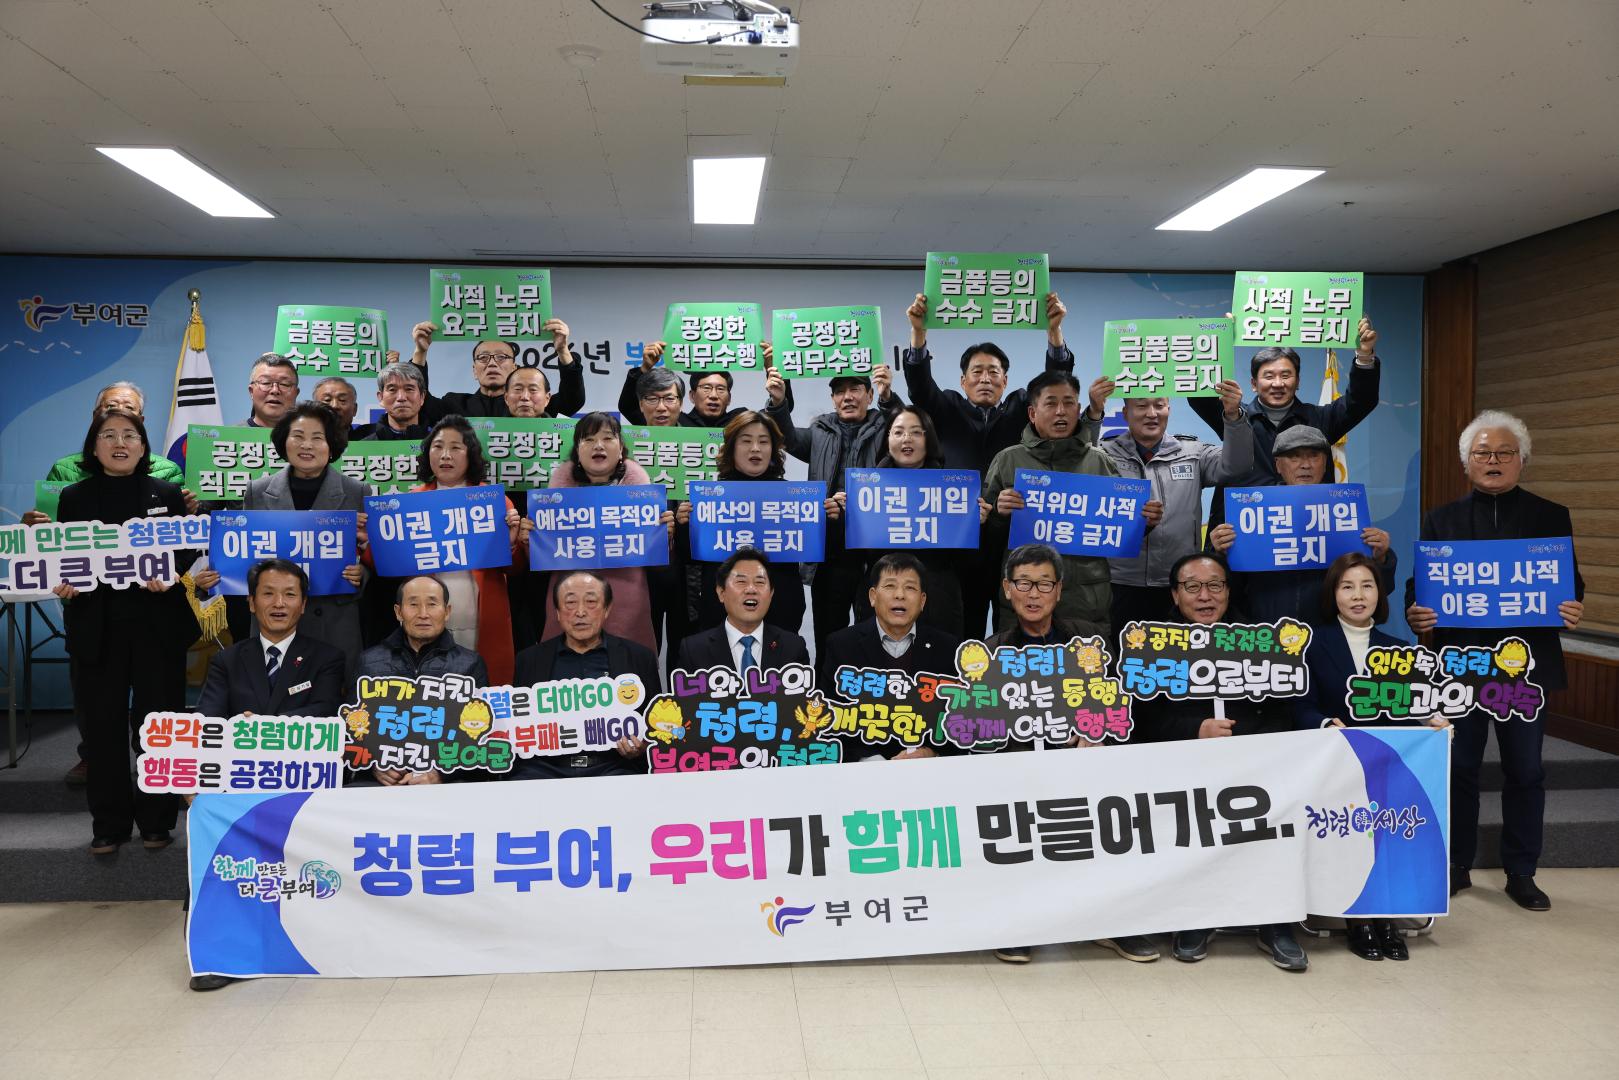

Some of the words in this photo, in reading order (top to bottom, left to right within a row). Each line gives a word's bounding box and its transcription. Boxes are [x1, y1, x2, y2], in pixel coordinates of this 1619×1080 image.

[442, 284, 486, 309] 사적
[494, 284, 541, 308] 노무
[939, 269, 1036, 297] 금품등의
[72, 302, 149, 326] 부여군
[935, 299, 985, 325] 수수
[991, 299, 1039, 325] 금지
[1243, 288, 1293, 315] 사적
[1301, 288, 1352, 315] 노무
[288, 319, 379, 346] 금품등의
[442, 312, 488, 337] 요구
[495, 312, 541, 337] 금지
[680, 316, 747, 341] 공정한
[791, 320, 860, 347] 공정한
[1242, 317, 1291, 343] 요구
[1300, 317, 1349, 343] 금지
[285, 346, 330, 372] 수수
[338, 348, 383, 373] 금지
[671, 343, 757, 369] 직무수행
[782, 348, 872, 375] 직무수행
[1119, 334, 1219, 363] 금품등의
[1114, 365, 1165, 394] 수수
[1173, 364, 1222, 393] 금지
[487, 432, 563, 458] 공정한
[341, 454, 419, 481] 공정한
[697, 501, 756, 524] 예산의
[761, 501, 819, 524] 목적외
[858, 486, 908, 514] 이권
[918, 486, 968, 514] 개입
[1026, 490, 1088, 517] 직위의
[1095, 496, 1137, 521] 사적
[379, 511, 432, 541] 이권
[442, 504, 496, 534] 개입
[535, 507, 595, 531] 예산의
[601, 505, 661, 527] 목적외
[888, 516, 938, 544] 금지
[1239, 505, 1293, 535] 이권
[1305, 502, 1359, 533] 개입
[0, 529, 26, 554] 께
[36, 525, 119, 552] 만드는
[128, 519, 210, 547] 청렴한
[222, 530, 278, 559] 이권
[289, 530, 344, 559] 개입
[553, 536, 595, 558] 사용
[603, 534, 646, 557] 금지
[713, 530, 755, 552] 사용
[763, 530, 803, 552] 금지
[1034, 520, 1075, 544] 이용
[1082, 525, 1123, 548] 금지
[414, 540, 468, 570] 금지
[1273, 536, 1326, 566] 금지
[15, 559, 48, 589] 더
[60, 557, 92, 587] 큰
[104, 551, 170, 584] 부여
[1427, 561, 1500, 586] 직위의
[1510, 559, 1559, 584] 사적
[1441, 592, 1489, 616] 이용
[1498, 591, 1547, 616] 금지
[1149, 626, 1210, 651] 공직의
[1214, 628, 1280, 653] 첫걸음,
[998, 647, 1066, 678] 청렴!
[1122, 657, 1304, 696] 청렴으로부터
[1443, 650, 1498, 677] 청렴,
[361, 679, 415, 700] 내가
[421, 678, 473, 703] 지킨
[674, 671, 743, 699] 너와
[749, 668, 814, 695] 나의
[839, 670, 911, 699] 청렴한
[941, 684, 998, 709] 가치
[1001, 680, 1055, 710] 있는
[1062, 678, 1129, 707] 동행,
[482, 691, 530, 719] 렴은
[537, 683, 613, 714] 더하GO
[1351, 680, 1474, 716] 군민과의
[1480, 680, 1541, 718] 약속
[146, 717, 224, 749] 생각은
[233, 720, 340, 752] 청렴하게
[375, 705, 457, 741] 청렴,
[515, 721, 578, 753] 부패는
[584, 716, 639, 746] 빼GO
[696, 701, 792, 743] 청렴,
[946, 714, 1006, 743] 함께
[1014, 710, 1069, 739] 여는
[1075, 707, 1130, 738] 행복
[344, 745, 372, 766] 가
[379, 743, 430, 768] 지킨
[438, 740, 512, 769] 부여군
[143, 757, 222, 788] 행동은
[229, 759, 337, 790] 공정하게
[353, 832, 475, 897] 청렴
[494, 826, 633, 893] 부여,
[649, 814, 830, 885] 우리가
[842, 805, 962, 875] 함께
[976, 784, 1296, 865] 만들어가요.
[215, 857, 254, 879] 함께
[257, 864, 287, 876] 만드는
[825, 896, 929, 926] 부여군
